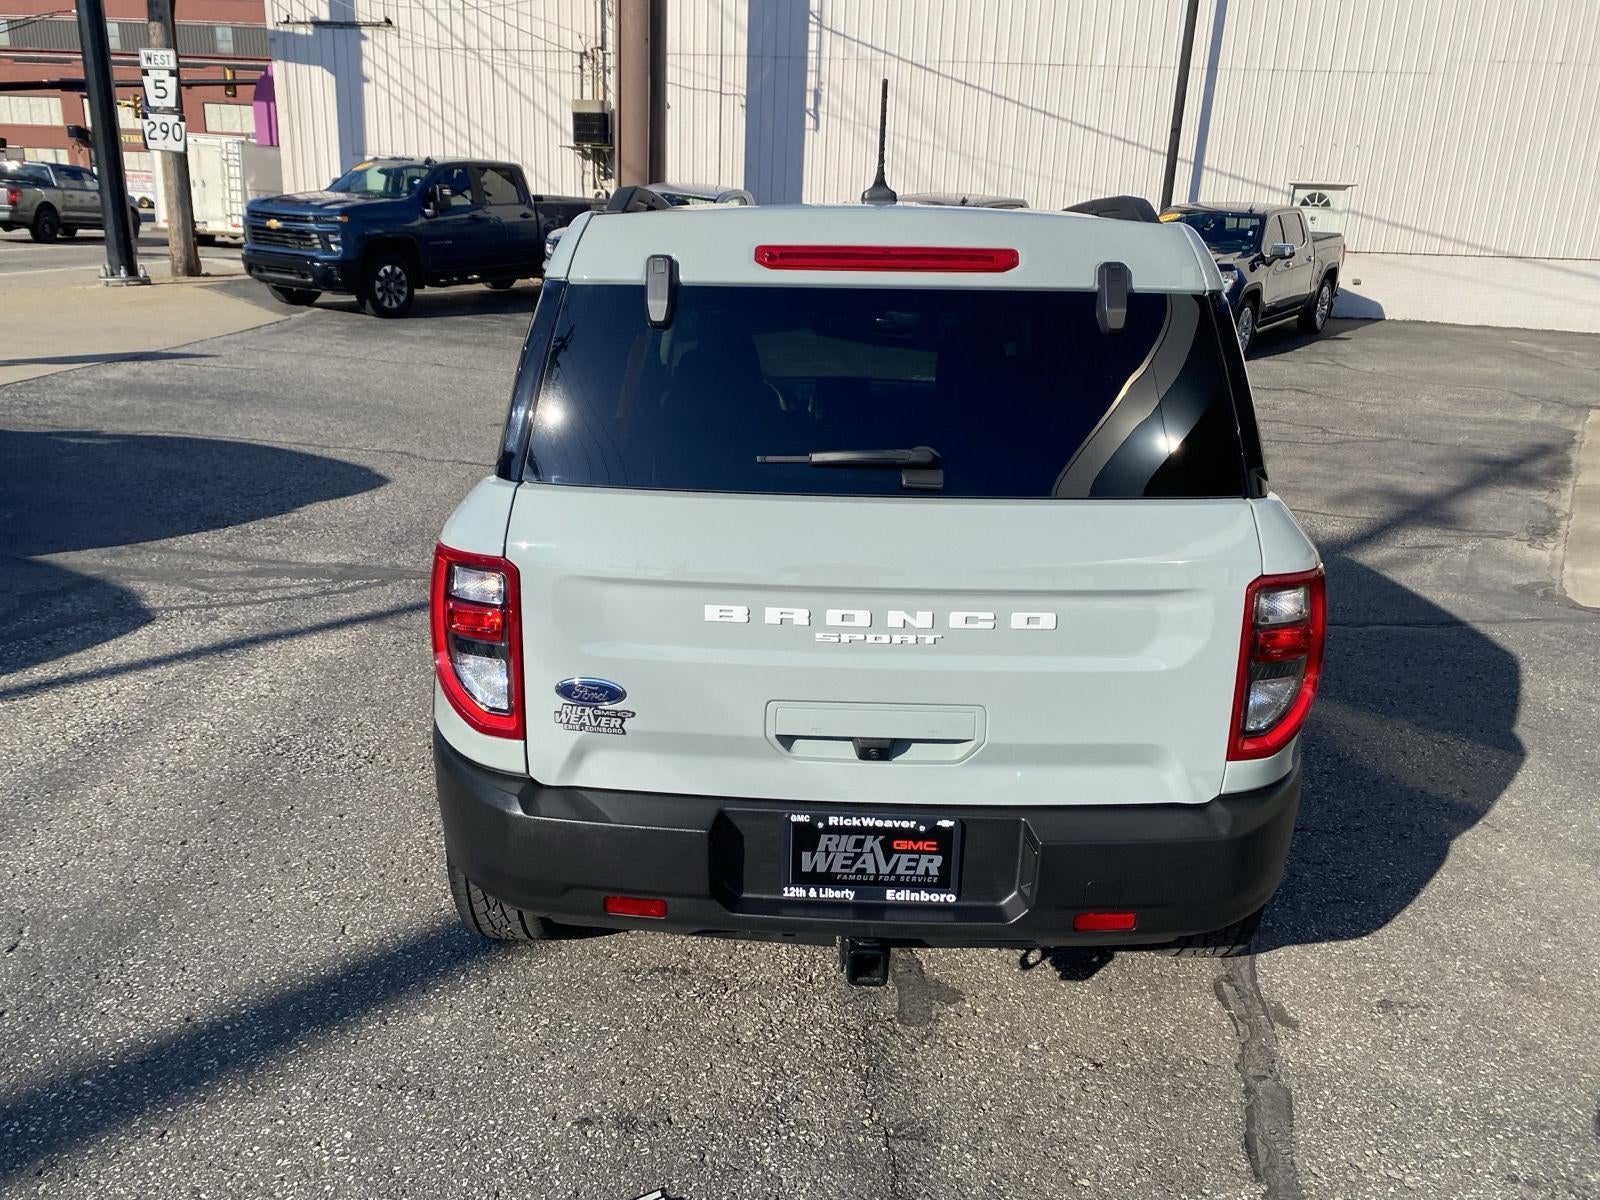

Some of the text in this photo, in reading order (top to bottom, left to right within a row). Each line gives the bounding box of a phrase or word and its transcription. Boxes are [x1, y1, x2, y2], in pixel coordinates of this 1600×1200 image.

[144, 52, 171, 66] WEST
[154, 79, 168, 99] 5
[147, 121, 183, 142] 290
[704, 604, 1059, 631] BRONCO
[815, 632, 944, 645] SPORT
[571, 684, 609, 701] Ford
[561, 704, 595, 716] RICK
[555, 711, 622, 729] WEAVER
[563, 723, 624, 735] ERIE EDINBORO
[790, 814, 811, 823] GMC
[828, 816, 917, 829] RickWeaver
[816, 834, 939, 852] RICK GMC
[801, 851, 943, 876] WEAVER
[836, 873, 875, 882] FAMOUS
[899, 875, 939, 883] SERVICE
[783, 886, 856, 901] 12th & Liberty
[885, 889, 957, 903] Edinboro
